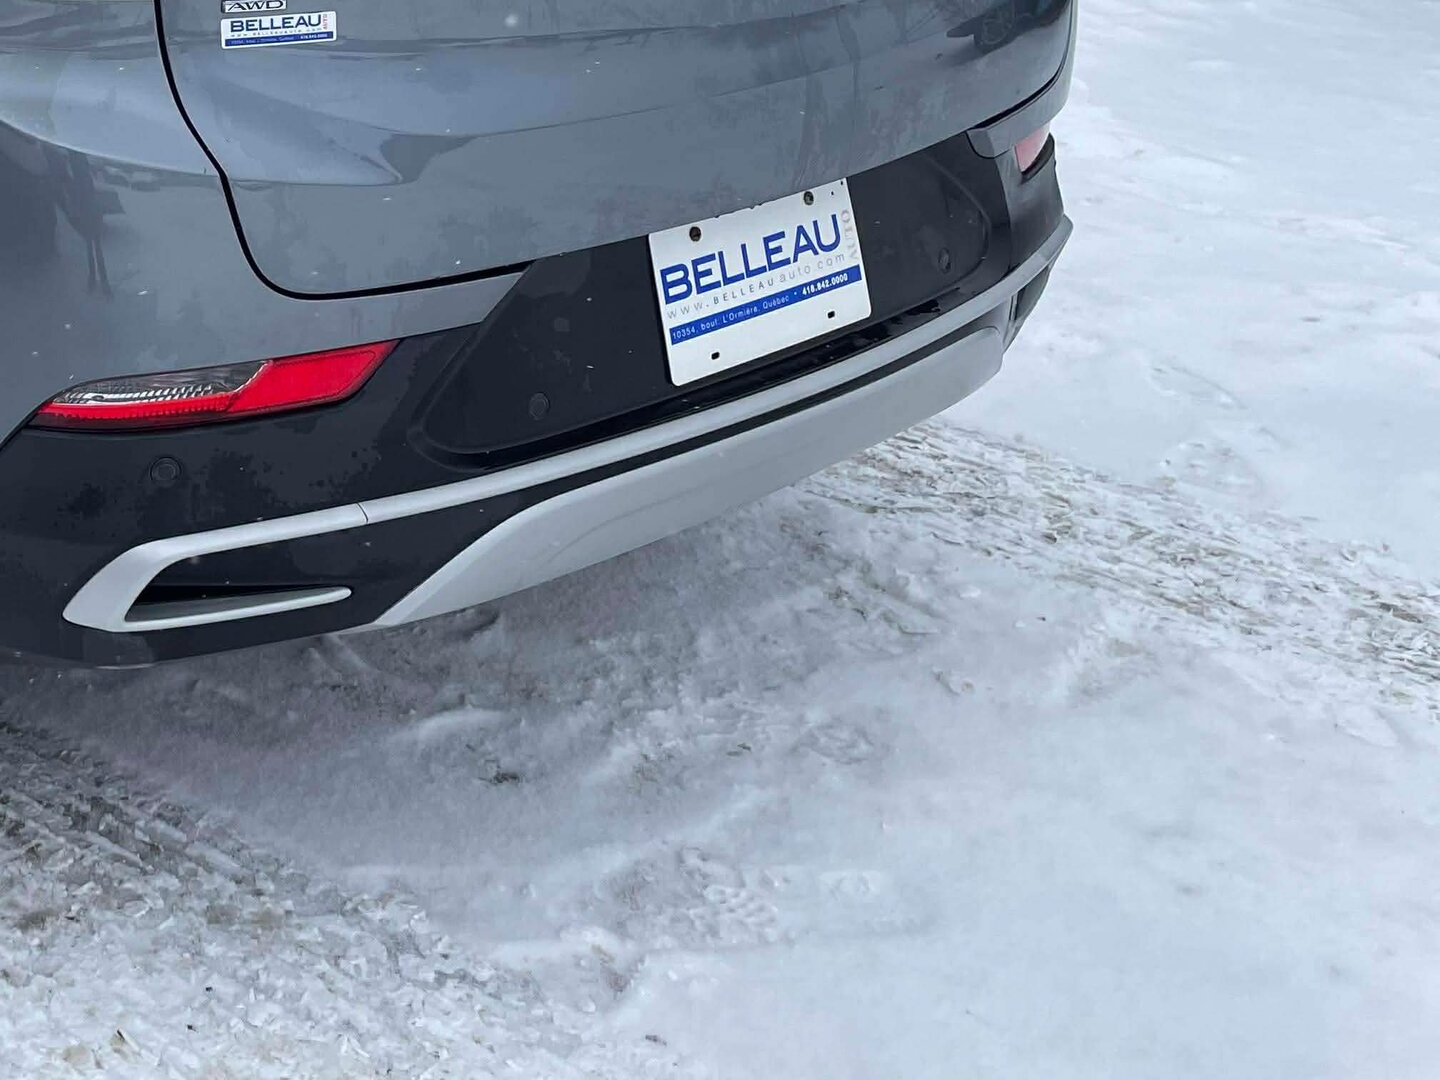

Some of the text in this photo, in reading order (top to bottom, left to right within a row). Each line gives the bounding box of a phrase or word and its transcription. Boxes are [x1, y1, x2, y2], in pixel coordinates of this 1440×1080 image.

[227, 0, 284, 12] AWD
[230, 14, 322, 33] BELLEAU
[660, 213, 842, 305] BELLEAU
